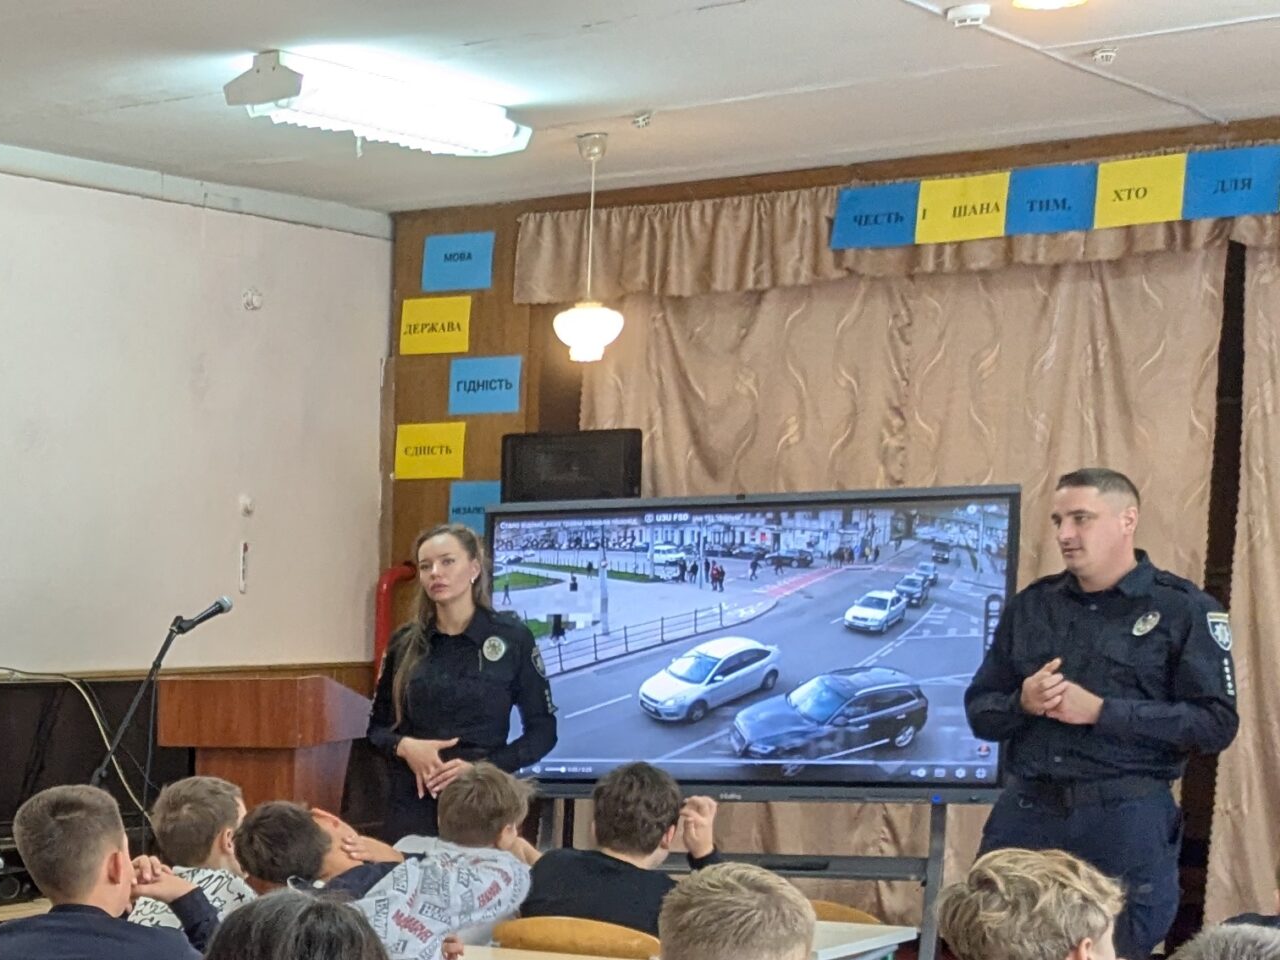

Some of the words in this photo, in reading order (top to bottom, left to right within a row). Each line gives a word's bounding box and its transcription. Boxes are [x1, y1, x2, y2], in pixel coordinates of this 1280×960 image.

[852, 211, 904, 227] ЧЕСТЬ
[921, 208, 927, 221] І
[952, 202, 1001, 218] ШАНА
[1112, 187, 1148, 202] ХТО
[1212, 178, 1252, 194] ДЛЯ
[443, 252, 472, 263] МОВА
[403, 322, 462, 335] ДЕРЖАВА
[456, 379, 513, 393] ГІДНІСТЬ
[404, 445, 452, 456] ЄДНІСТЬ
